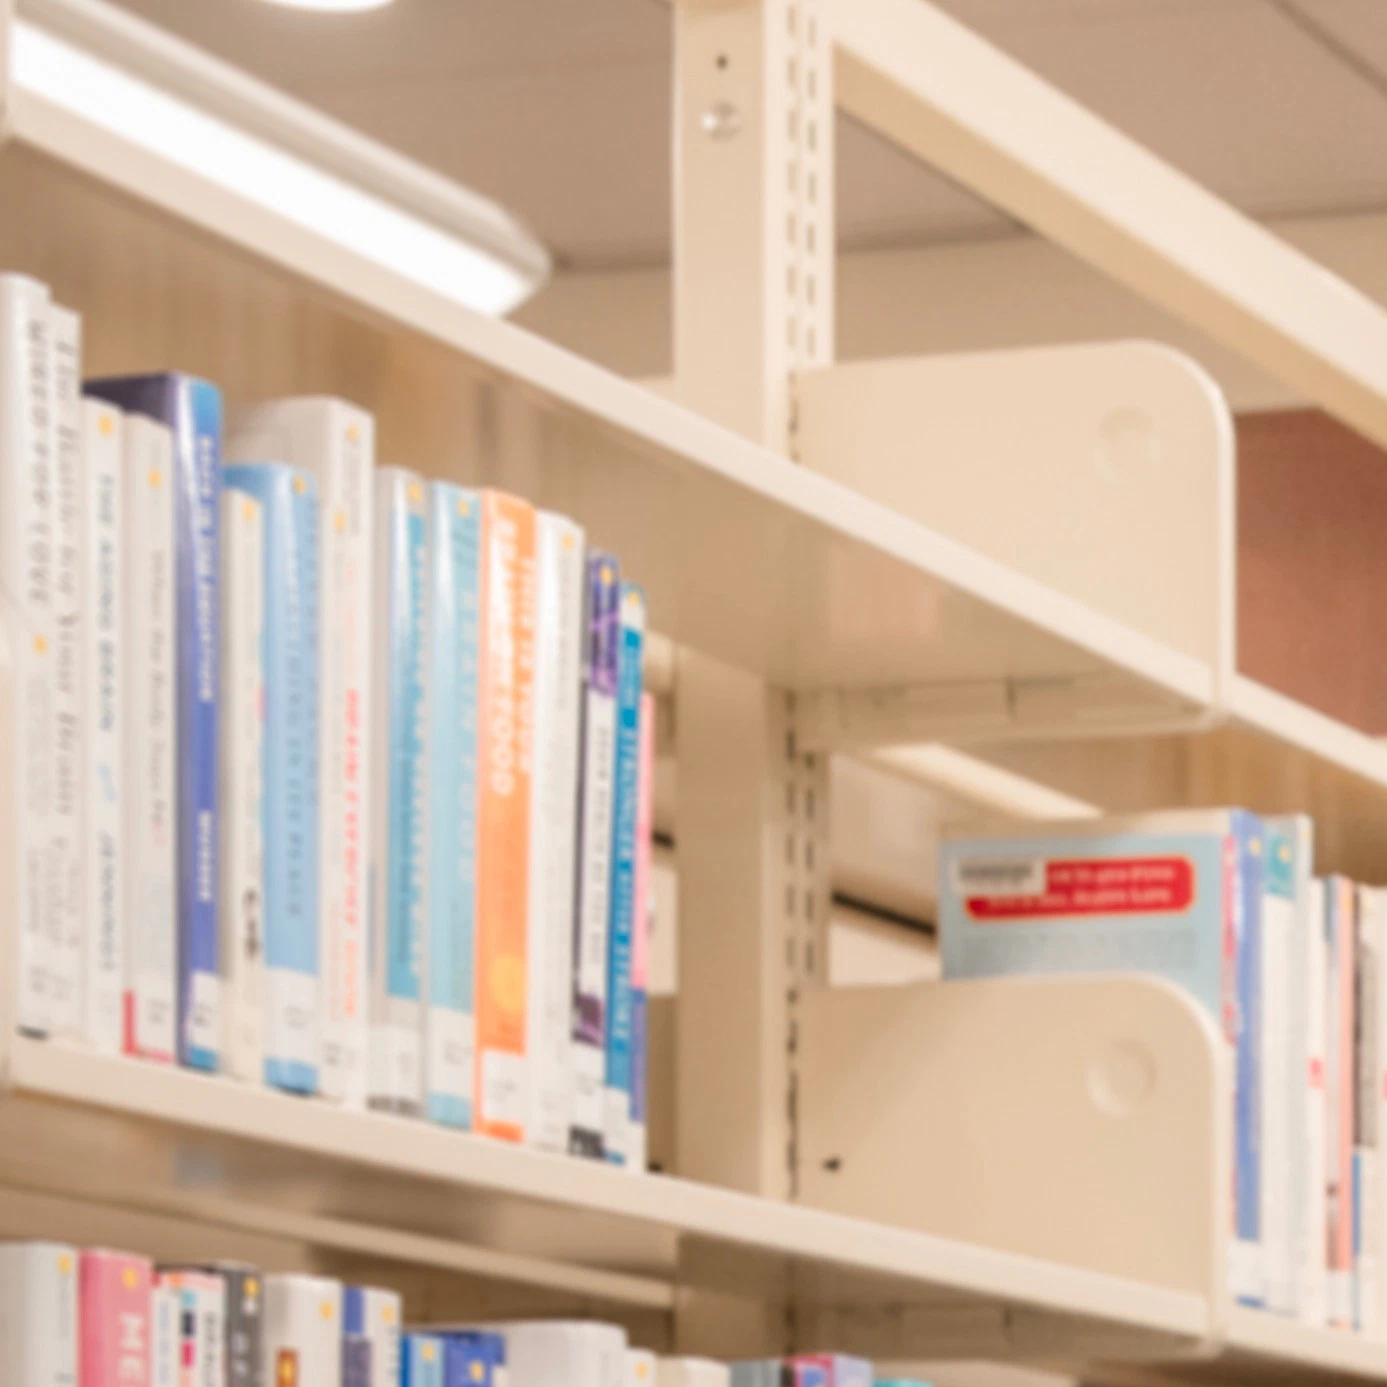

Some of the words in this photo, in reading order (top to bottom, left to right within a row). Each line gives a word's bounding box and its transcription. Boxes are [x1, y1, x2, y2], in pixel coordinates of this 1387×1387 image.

[98, 474, 115, 527] THE
[98, 538, 115, 632] AGING
[98, 639, 115, 733] BRAIN
